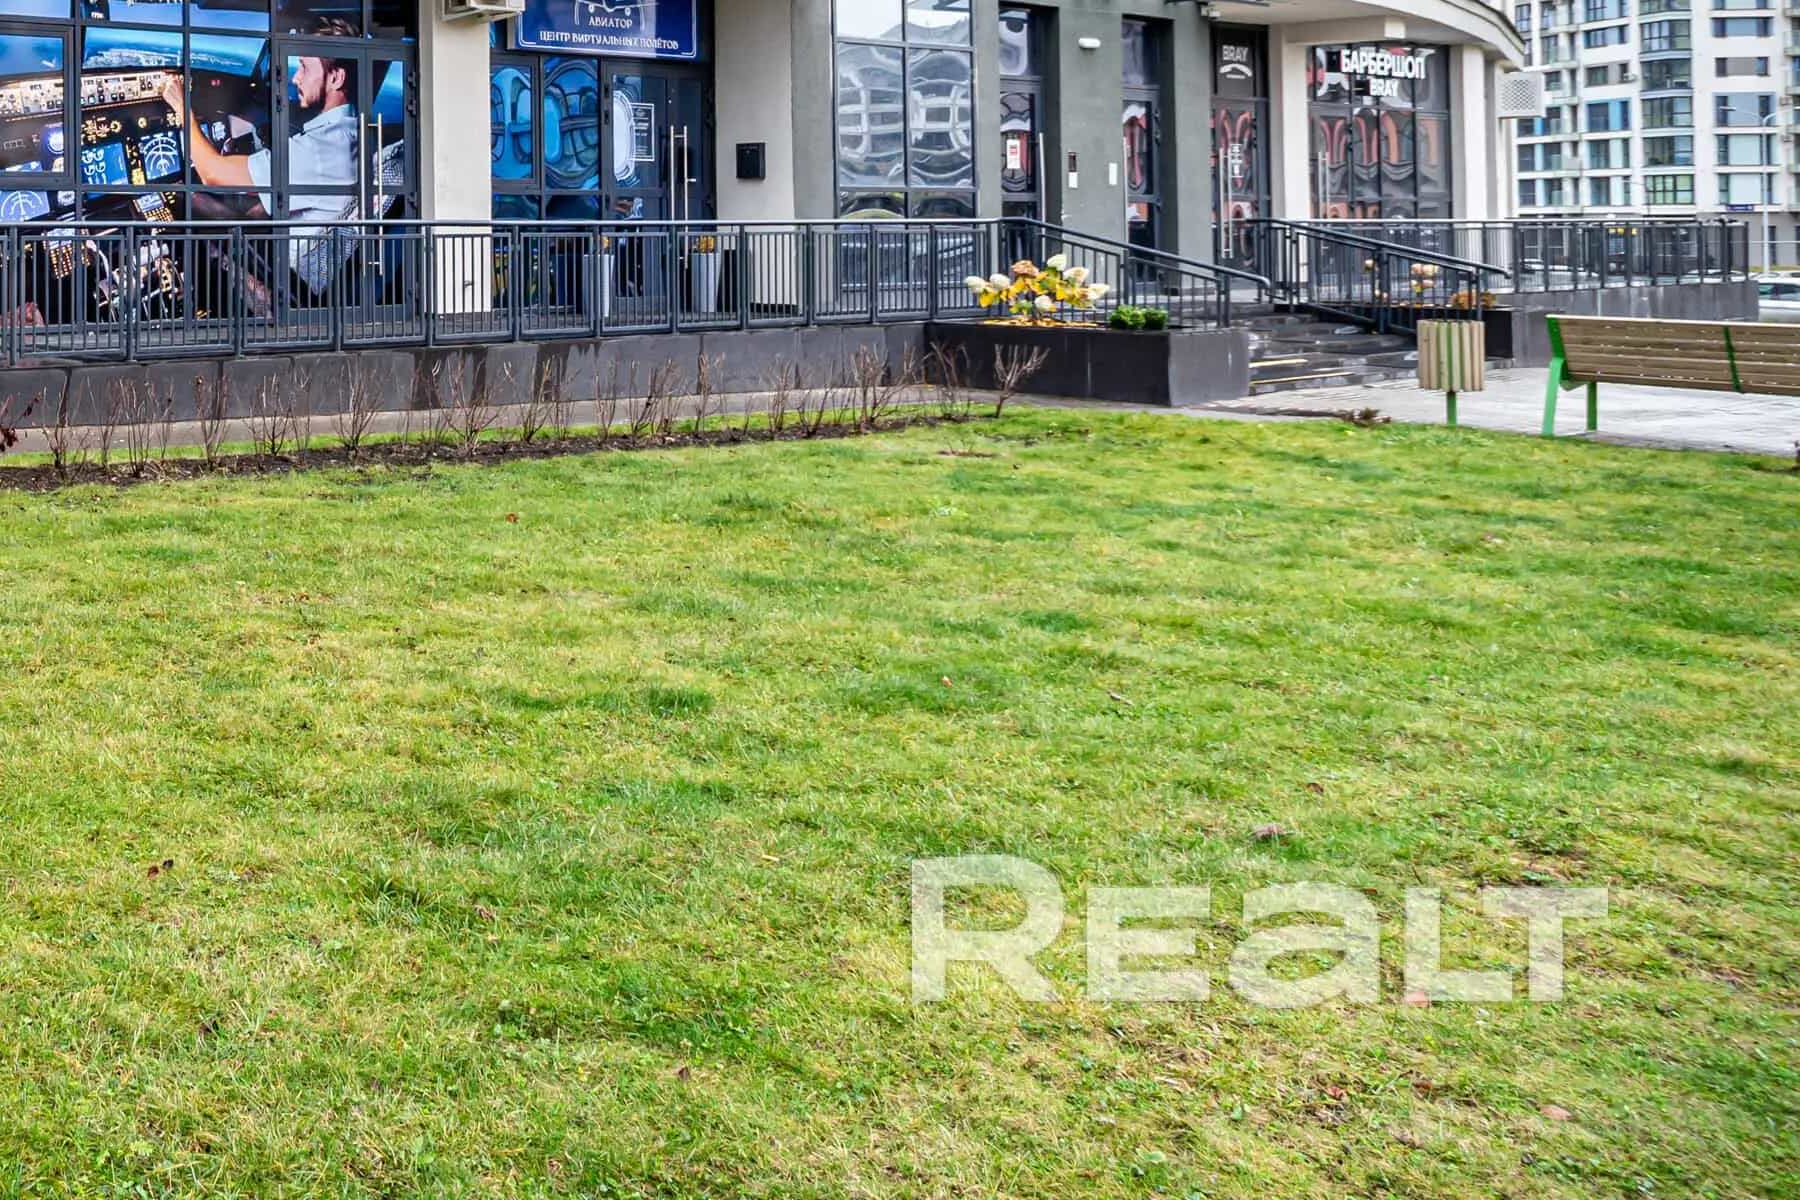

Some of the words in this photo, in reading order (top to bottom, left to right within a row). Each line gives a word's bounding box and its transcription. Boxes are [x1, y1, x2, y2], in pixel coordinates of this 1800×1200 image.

[588, 16, 633, 29] АВИАТОР
[540, 31, 571, 42] ЦЕНТР
[572, 33, 638, 47] ВИРТУАЛЬНЫХ
[1222, 44, 1248, 62] BRAY
[1341, 49, 1426, 80] БАРБЕРШОП
[1369, 78, 1399, 97] BRAY
